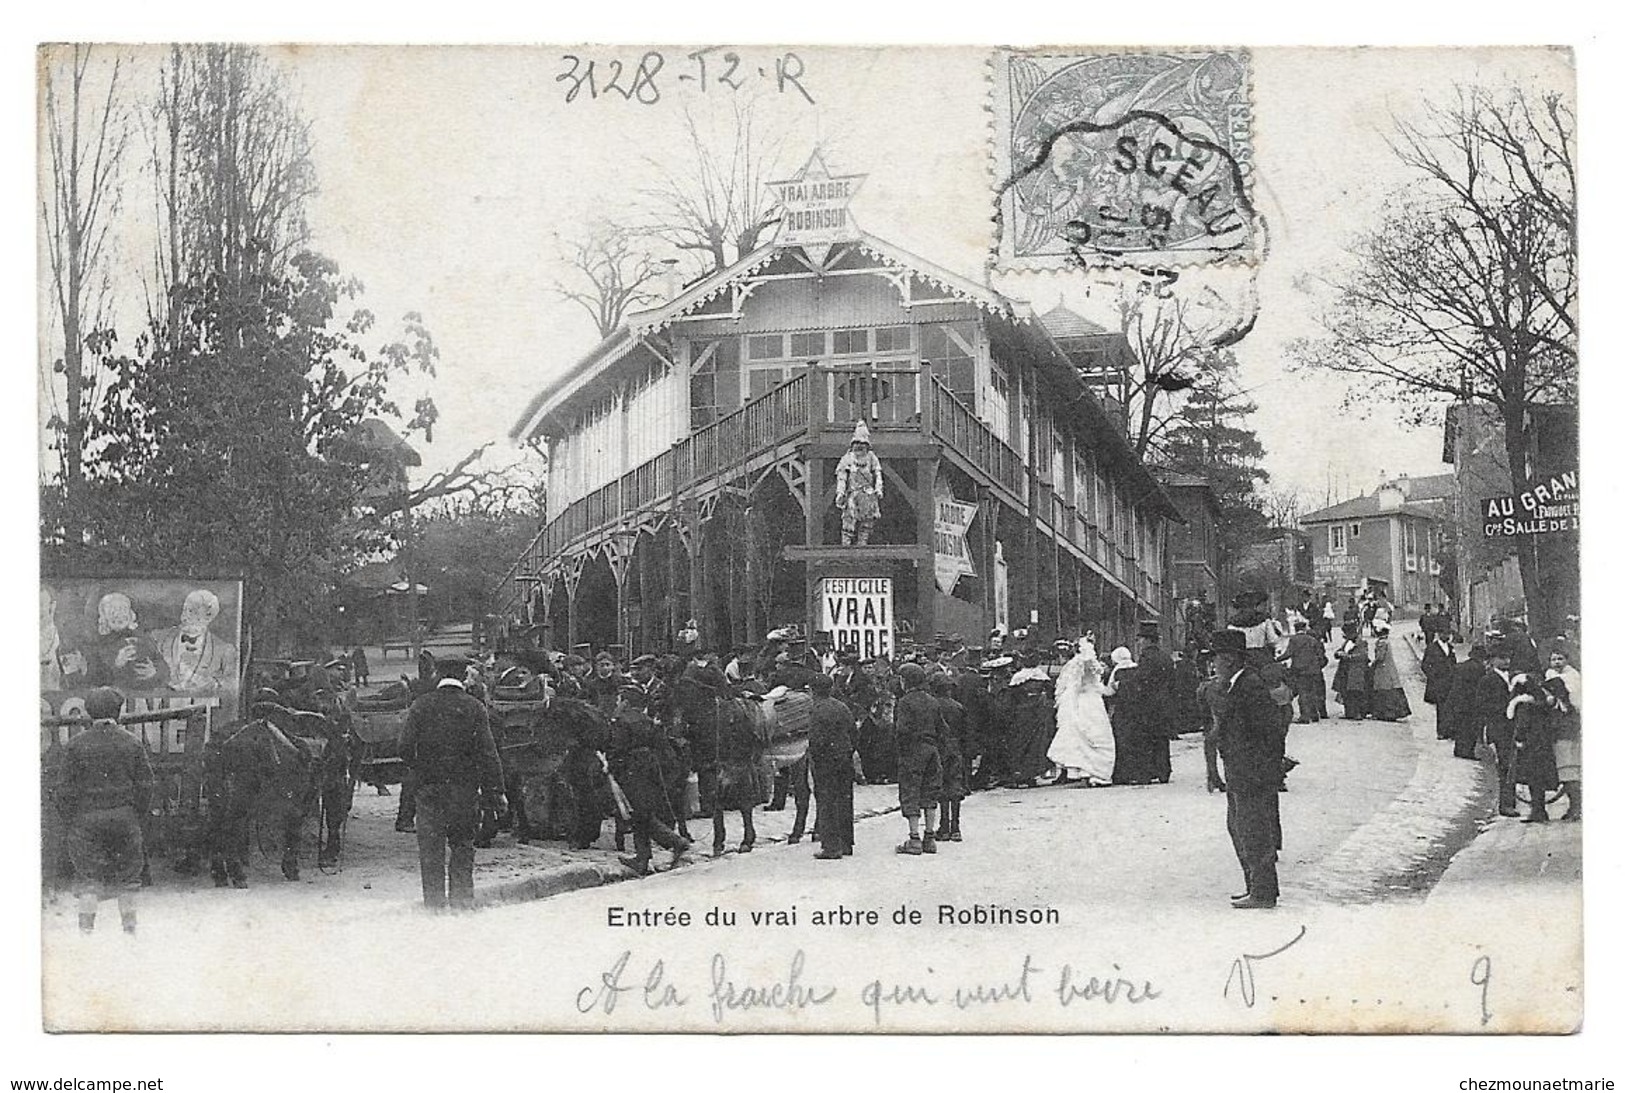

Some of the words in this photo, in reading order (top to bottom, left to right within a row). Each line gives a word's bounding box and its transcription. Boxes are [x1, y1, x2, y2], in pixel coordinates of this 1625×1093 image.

[779, 184, 808, 202] VRAI
[811, 181, 850, 200] ARBRE
[788, 207, 847, 231] ROBINSON
[1487, 497, 1515, 517] AU
[1503, 518, 1548, 535] SALLE
[1550, 519, 1569, 531] DE
[828, 597, 886, 626] VRAI
[861, 967, 937, 1025] qui
